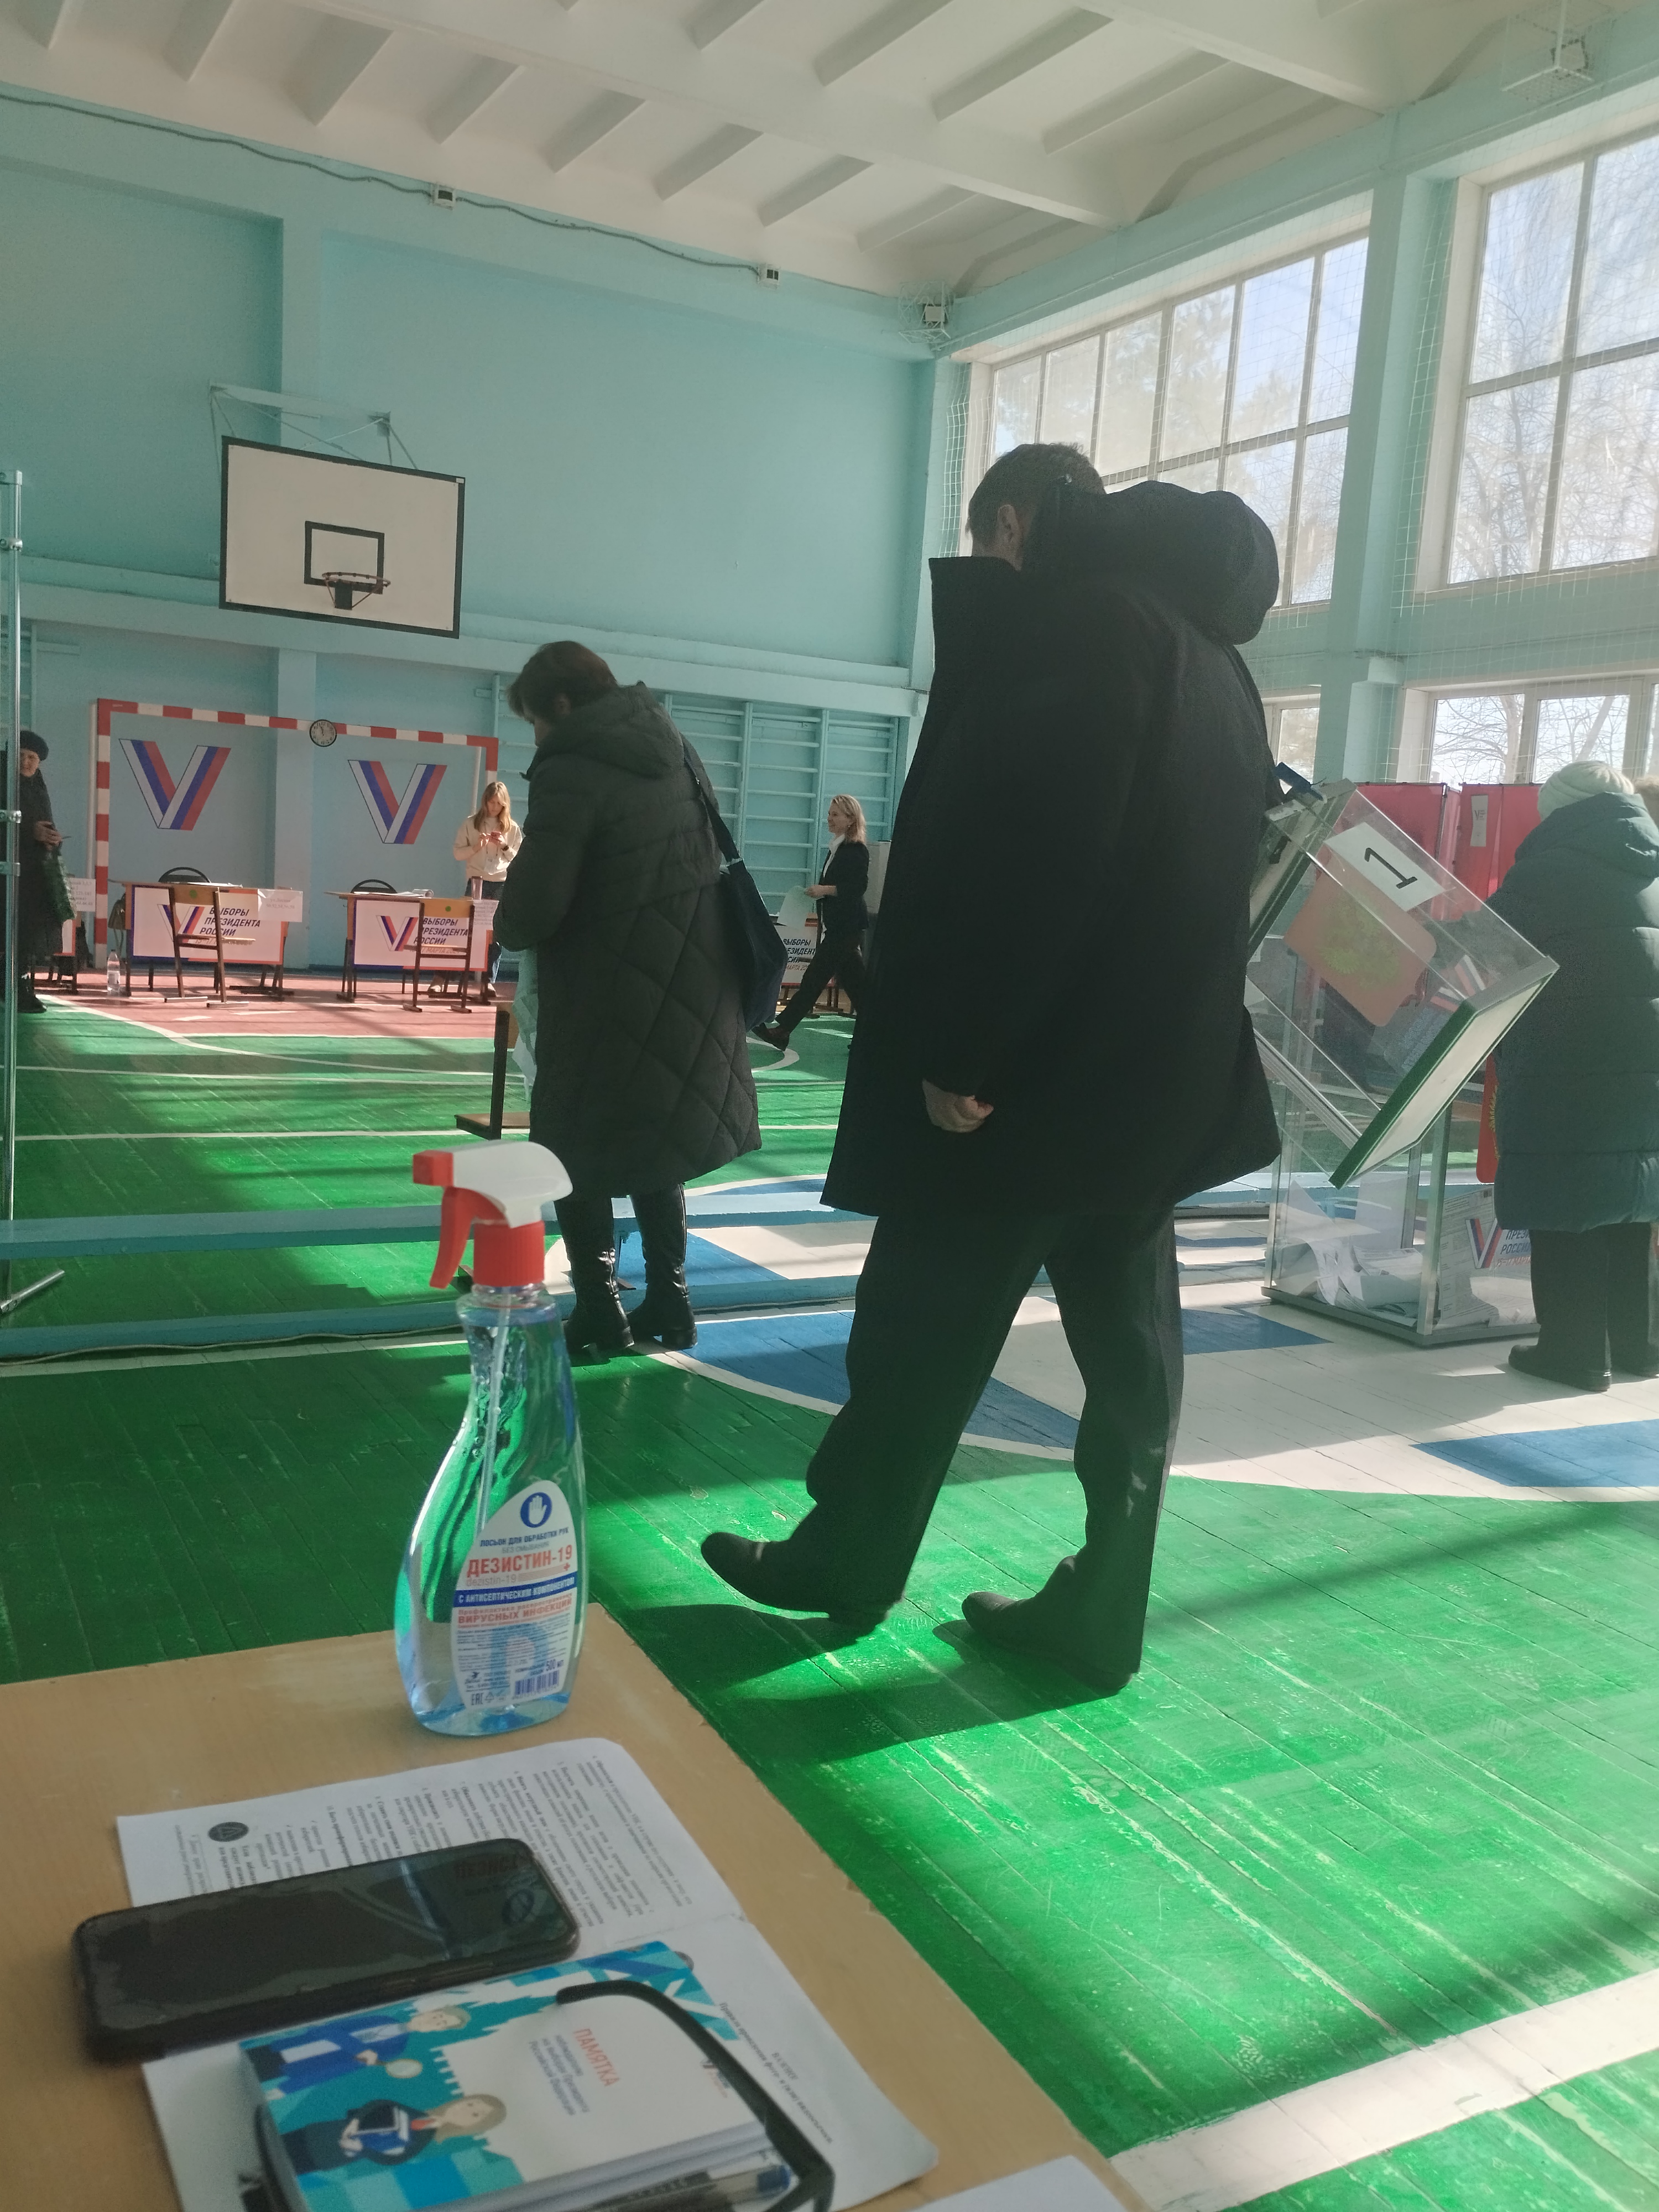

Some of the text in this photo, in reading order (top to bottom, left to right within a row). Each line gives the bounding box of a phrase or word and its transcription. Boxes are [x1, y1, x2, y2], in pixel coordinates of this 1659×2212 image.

[1364, 847, 1418, 889] 1
[209, 906, 250, 916] ВБОРЫ
[204, 917, 261, 927] ПРЗИДЕНТА
[199, 927, 236, 936] РОСИИ
[422, 927, 468, 936] РЕЗИДЕНТА
[467, 1545, 572, 1578] ДЕЗИСТИН-19
[458, 1612, 519, 1624] ВИРУСНЫХ
[523, 1598, 572, 1617] ИНФЕКЦИЙ
[573, 2028, 620, 2086] ПАМЯТКА
